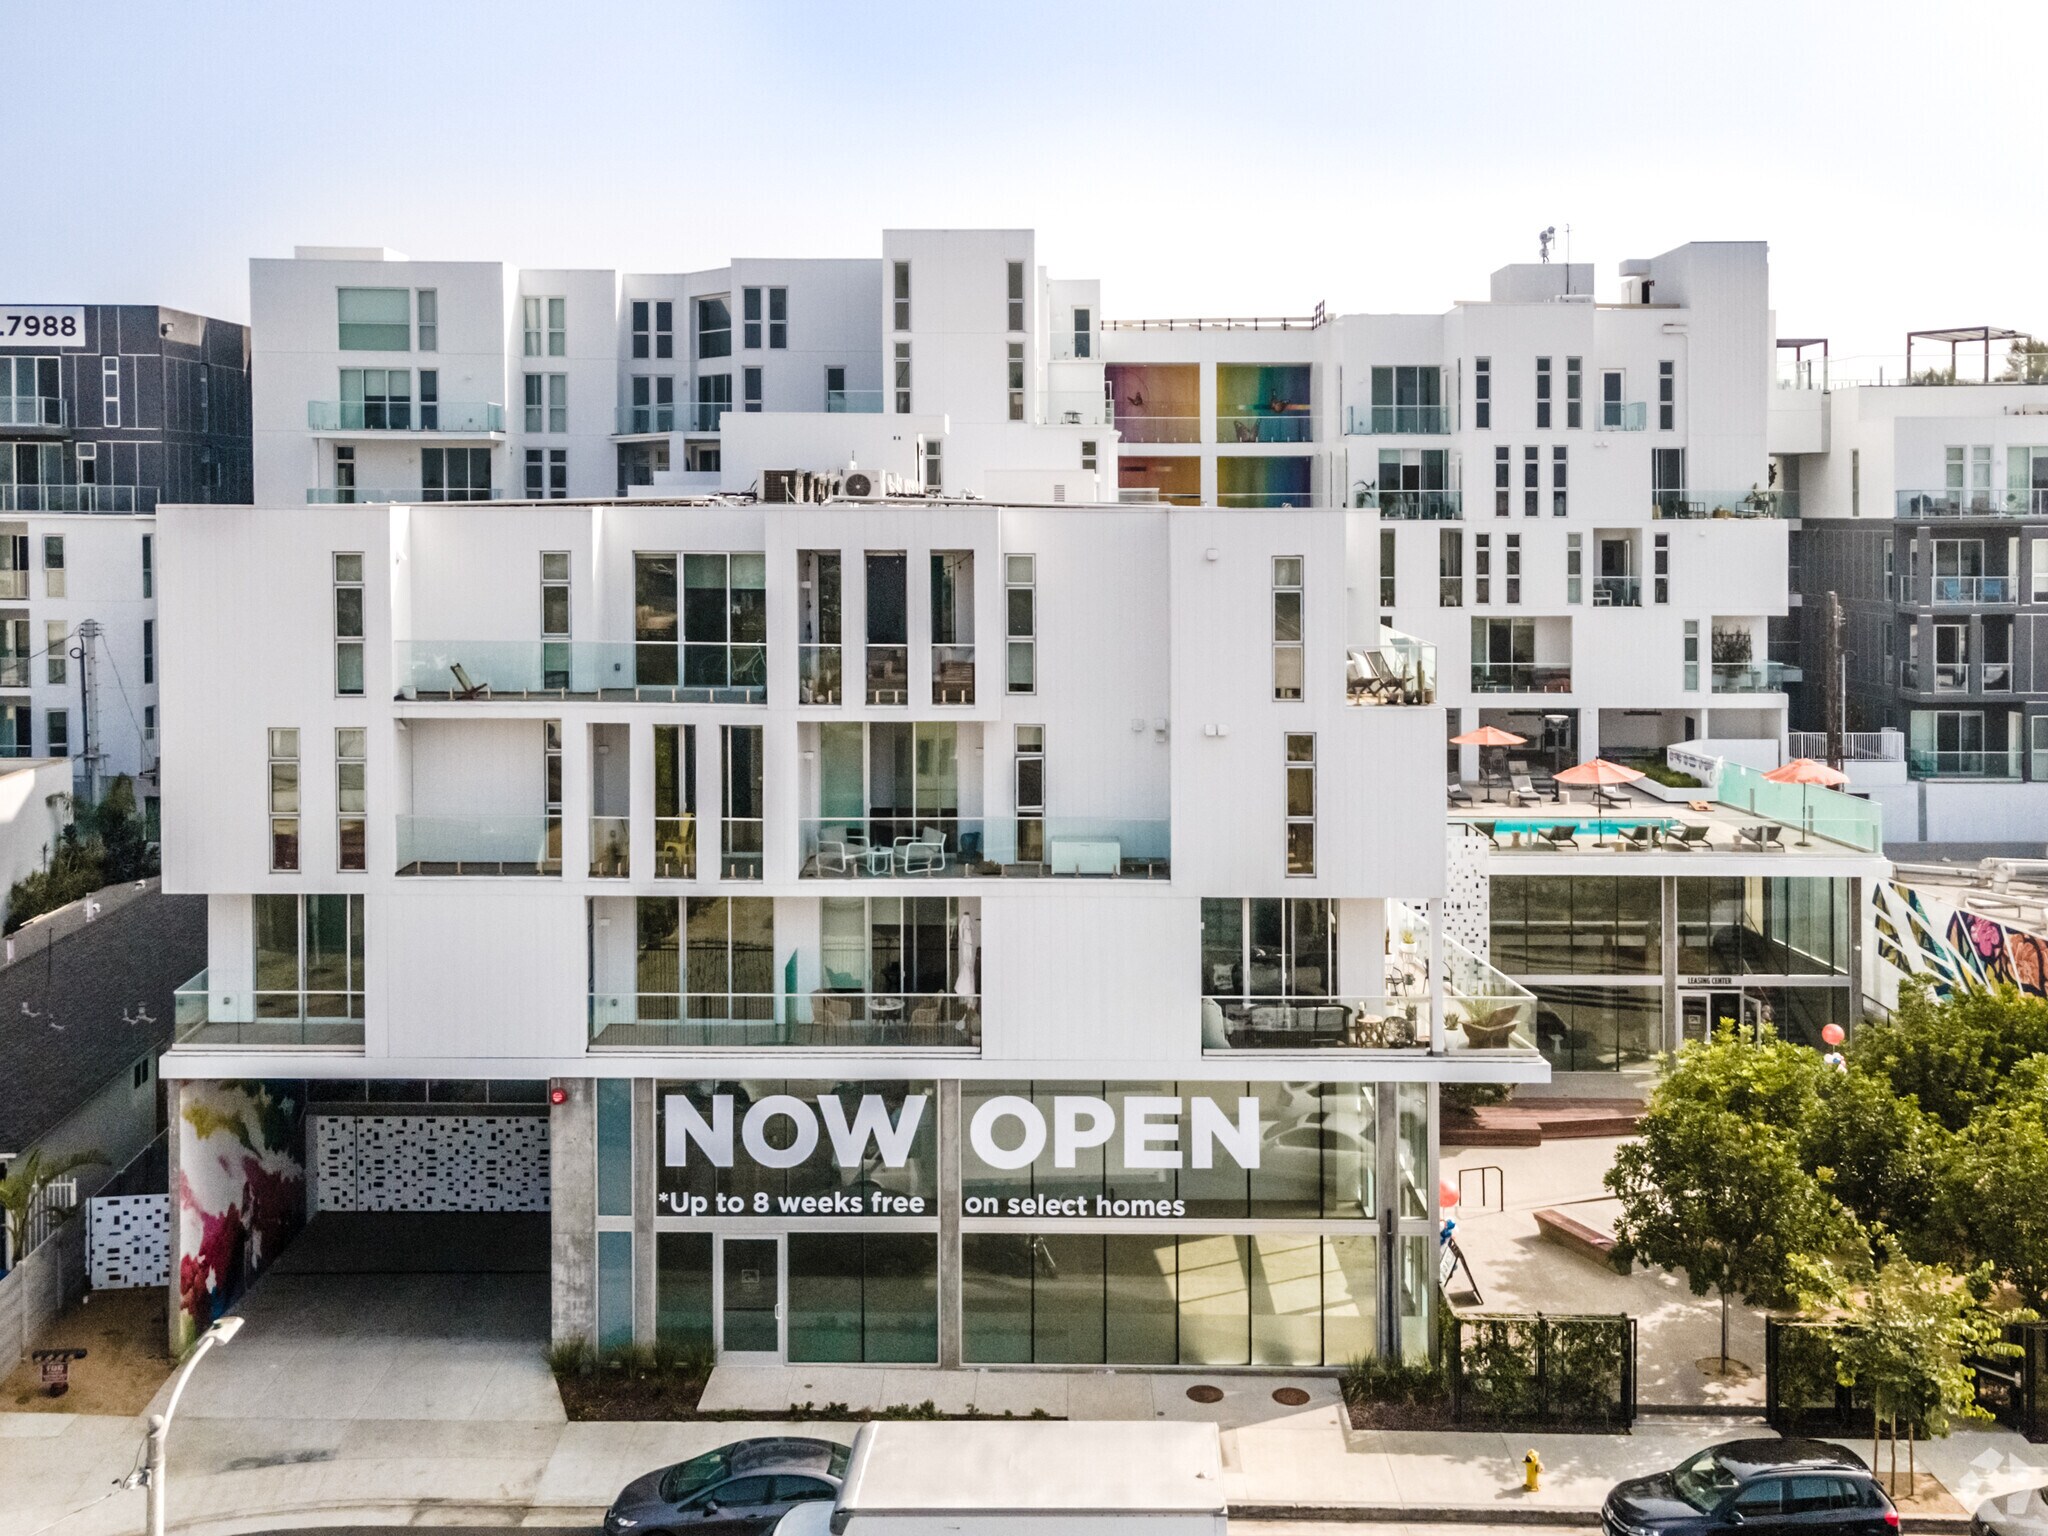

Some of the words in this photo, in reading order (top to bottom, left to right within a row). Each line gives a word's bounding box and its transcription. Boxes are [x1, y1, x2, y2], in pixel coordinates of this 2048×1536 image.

[665, 1094, 928, 1168] NOW
[970, 1095, 1260, 1169] OPEN
[715, 1192, 745, 1213] to
[753, 1192, 770, 1213] 8
[777, 1191, 863, 1213] weeks
[871, 1191, 925, 1213] free
[965, 1196, 999, 1214] on
[1007, 1193, 1088, 1216] select
[1096, 1194, 1186, 1216] homes
